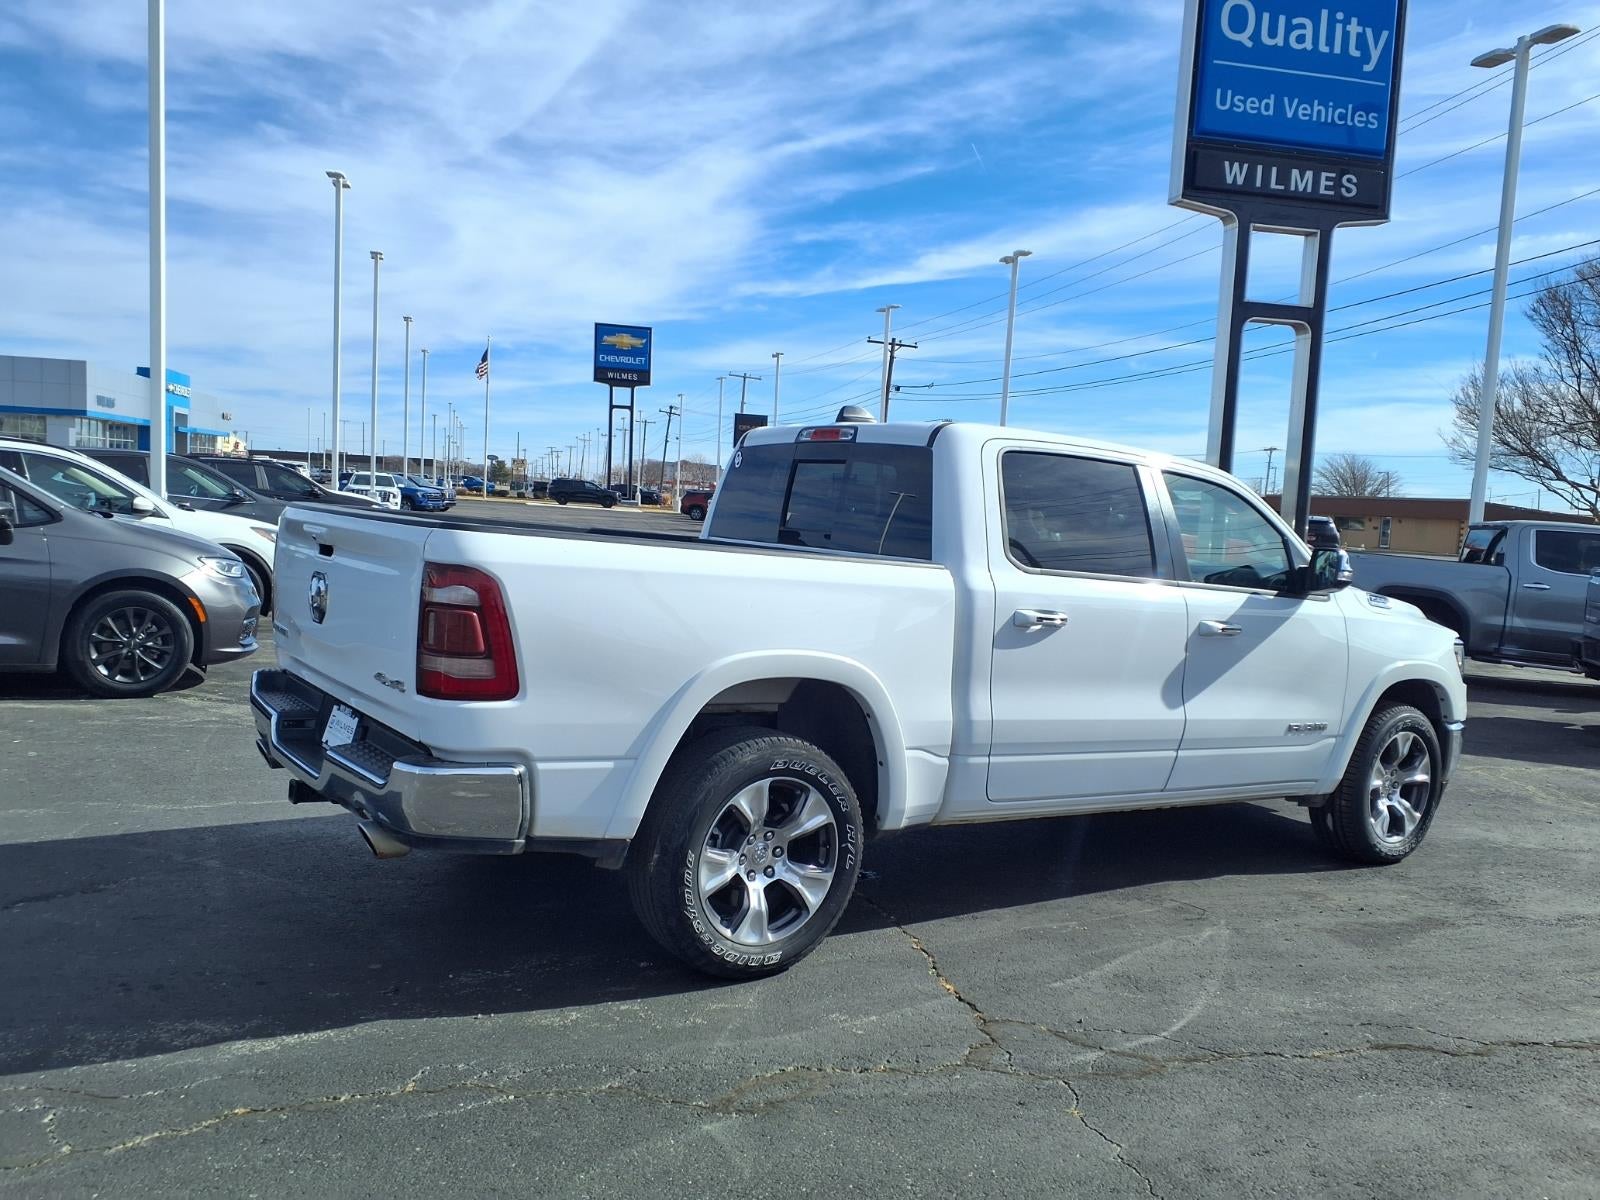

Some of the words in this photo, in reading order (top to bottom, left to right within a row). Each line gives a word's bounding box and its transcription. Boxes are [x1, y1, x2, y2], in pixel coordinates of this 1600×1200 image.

[1220, 0, 1390, 72] Quality
[1215, 88, 1275, 116] Used
[1284, 96, 1379, 129] Vehicles
[1224, 160, 1359, 198] WILMES
[599, 354, 646, 365] CHEVROLET
[607, 371, 638, 381] WILMES
[769, 759, 849, 813] DUELER
[845, 823, 856, 870] H/L
[683, 849, 783, 966] BRIDGESTONE
